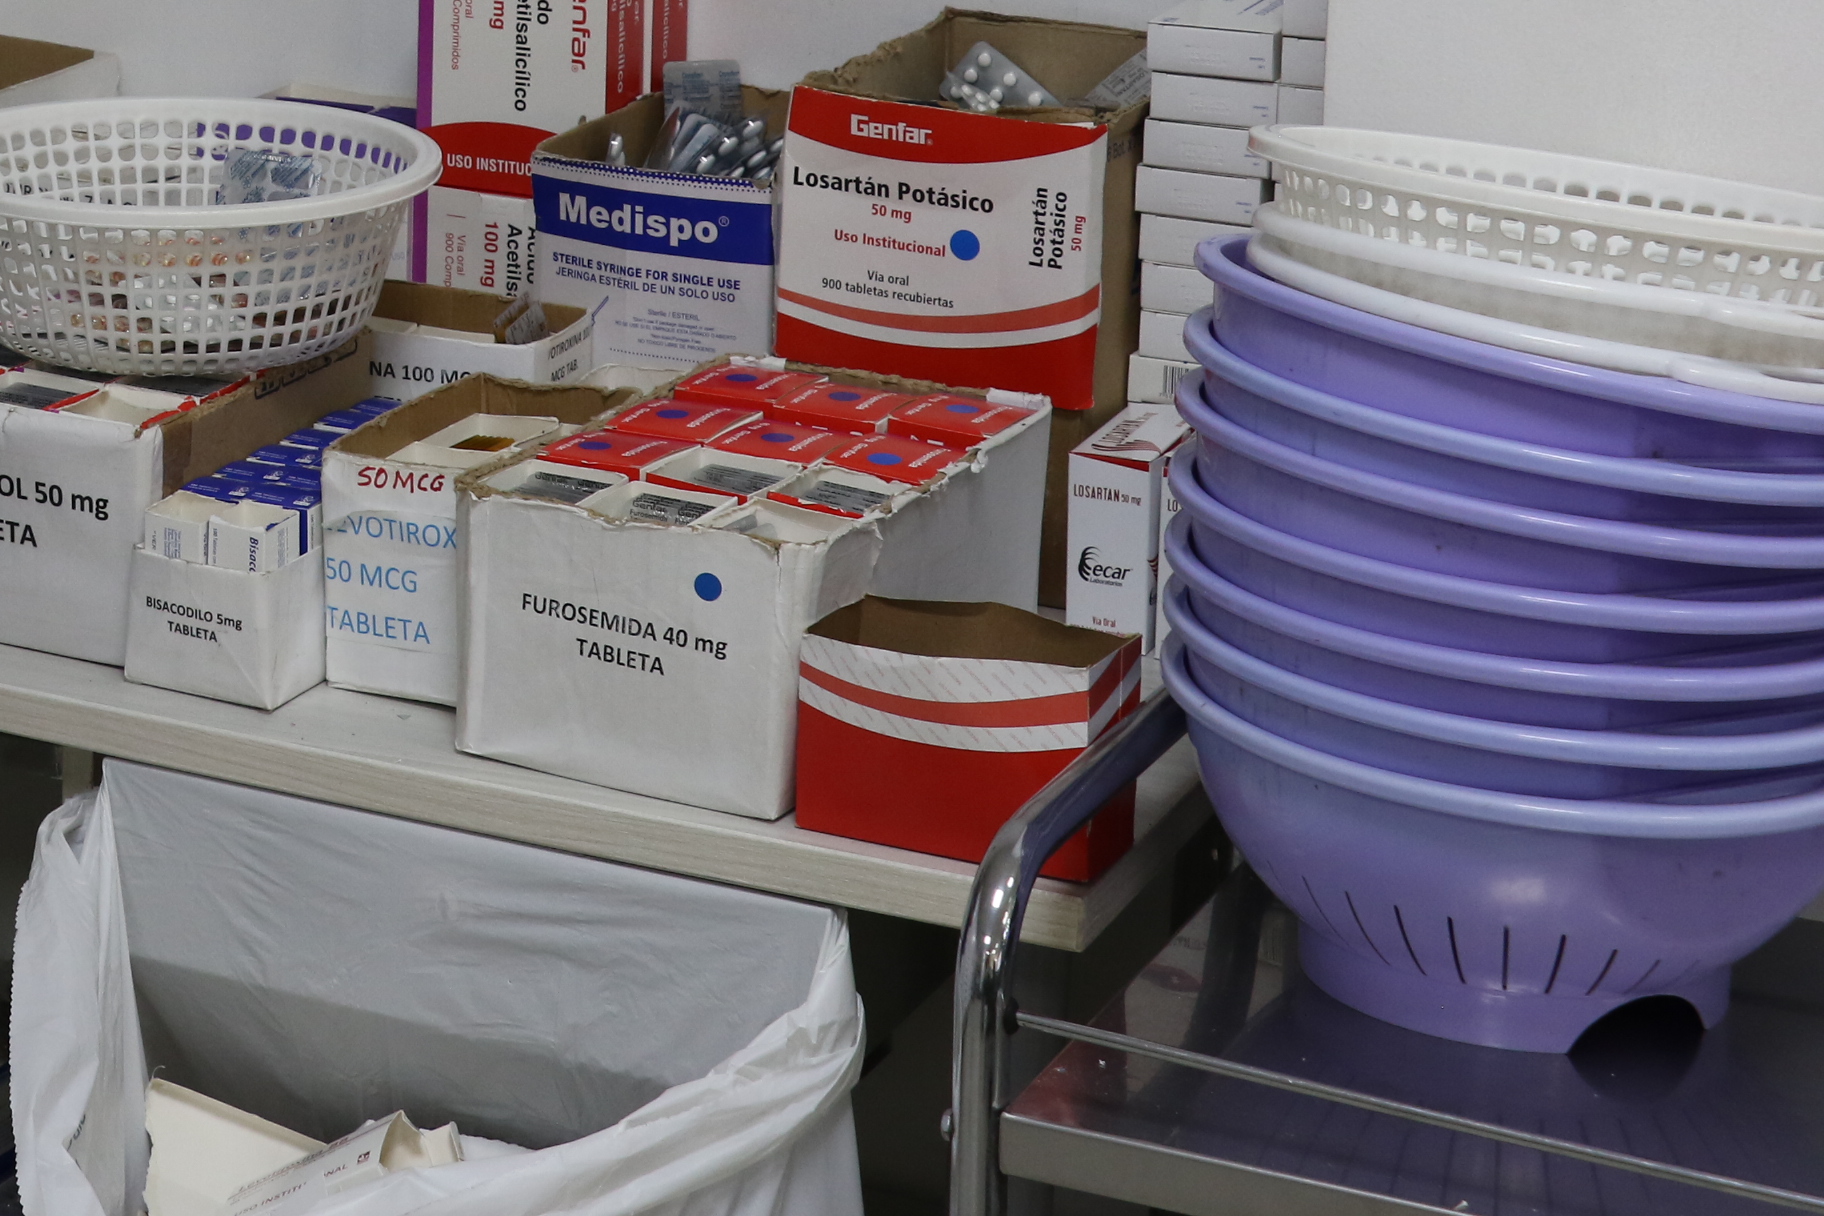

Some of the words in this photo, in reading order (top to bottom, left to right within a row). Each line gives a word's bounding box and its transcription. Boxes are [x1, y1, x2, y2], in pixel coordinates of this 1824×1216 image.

[489, 0, 505, 30] mg
[850, 113, 933, 145] Genfar
[446, 153, 473, 170] USO
[792, 165, 890, 199] Losartán
[897, 180, 995, 214] Potásico
[558, 191, 720, 248] Medispo
[870, 203, 888, 218] 50
[890, 207, 913, 224] mg
[1028, 186, 1049, 269] Losartán
[1072, 215, 1087, 233] mg
[445, 232, 455, 254] 900
[483, 221, 500, 254] 100
[834, 228, 859, 244] Uso
[862, 232, 947, 258] Institucional
[1047, 190, 1068, 270] Potásico
[1070, 235, 1082, 252] 50
[456, 255, 465, 276] oral
[480, 259, 496, 289] mg
[552, 251, 594, 270] STERILE
[596, 260, 643, 279] SYRINGE
[645, 268, 669, 282] FOR
[672, 272, 714, 288] SINGLE
[717, 278, 741, 291] USE
[887, 273, 910, 287] oral
[555, 266, 597, 284] JERINGA
[599, 274, 640, 292] ESTÉRIL
[642, 282, 657, 293] DE
[660, 284, 676, 296] UN
[678, 286, 709, 300] SOLO
[712, 290, 736, 303] USO
[821, 277, 843, 291] 900
[845, 279, 890, 299] tabletas
[892, 288, 955, 309] recubiertas
[401, 364, 435, 385] 100
[392, 470, 446, 494] MCG
[1073, 483, 1120, 503] LOSARTAN
[1121, 494, 1129, 504] 50
[1130, 495, 1142, 507] mg
[34, 481, 64, 508] 50
[71, 491, 110, 522] mg
[327, 515, 458, 550] VOTIROX
[326, 556, 353, 584] 50
[359, 562, 419, 594] MCG
[145, 595, 214, 624] BISACODILO
[216, 612, 244, 632] 5mg
[326, 605, 431, 646] TABLETA
[521, 592, 658, 642] FUROSEMIDA
[663, 625, 689, 649] 40
[693, 634, 729, 662] mg
[167, 620, 218, 644] TABLETA
[576, 637, 666, 677] TABLETA
